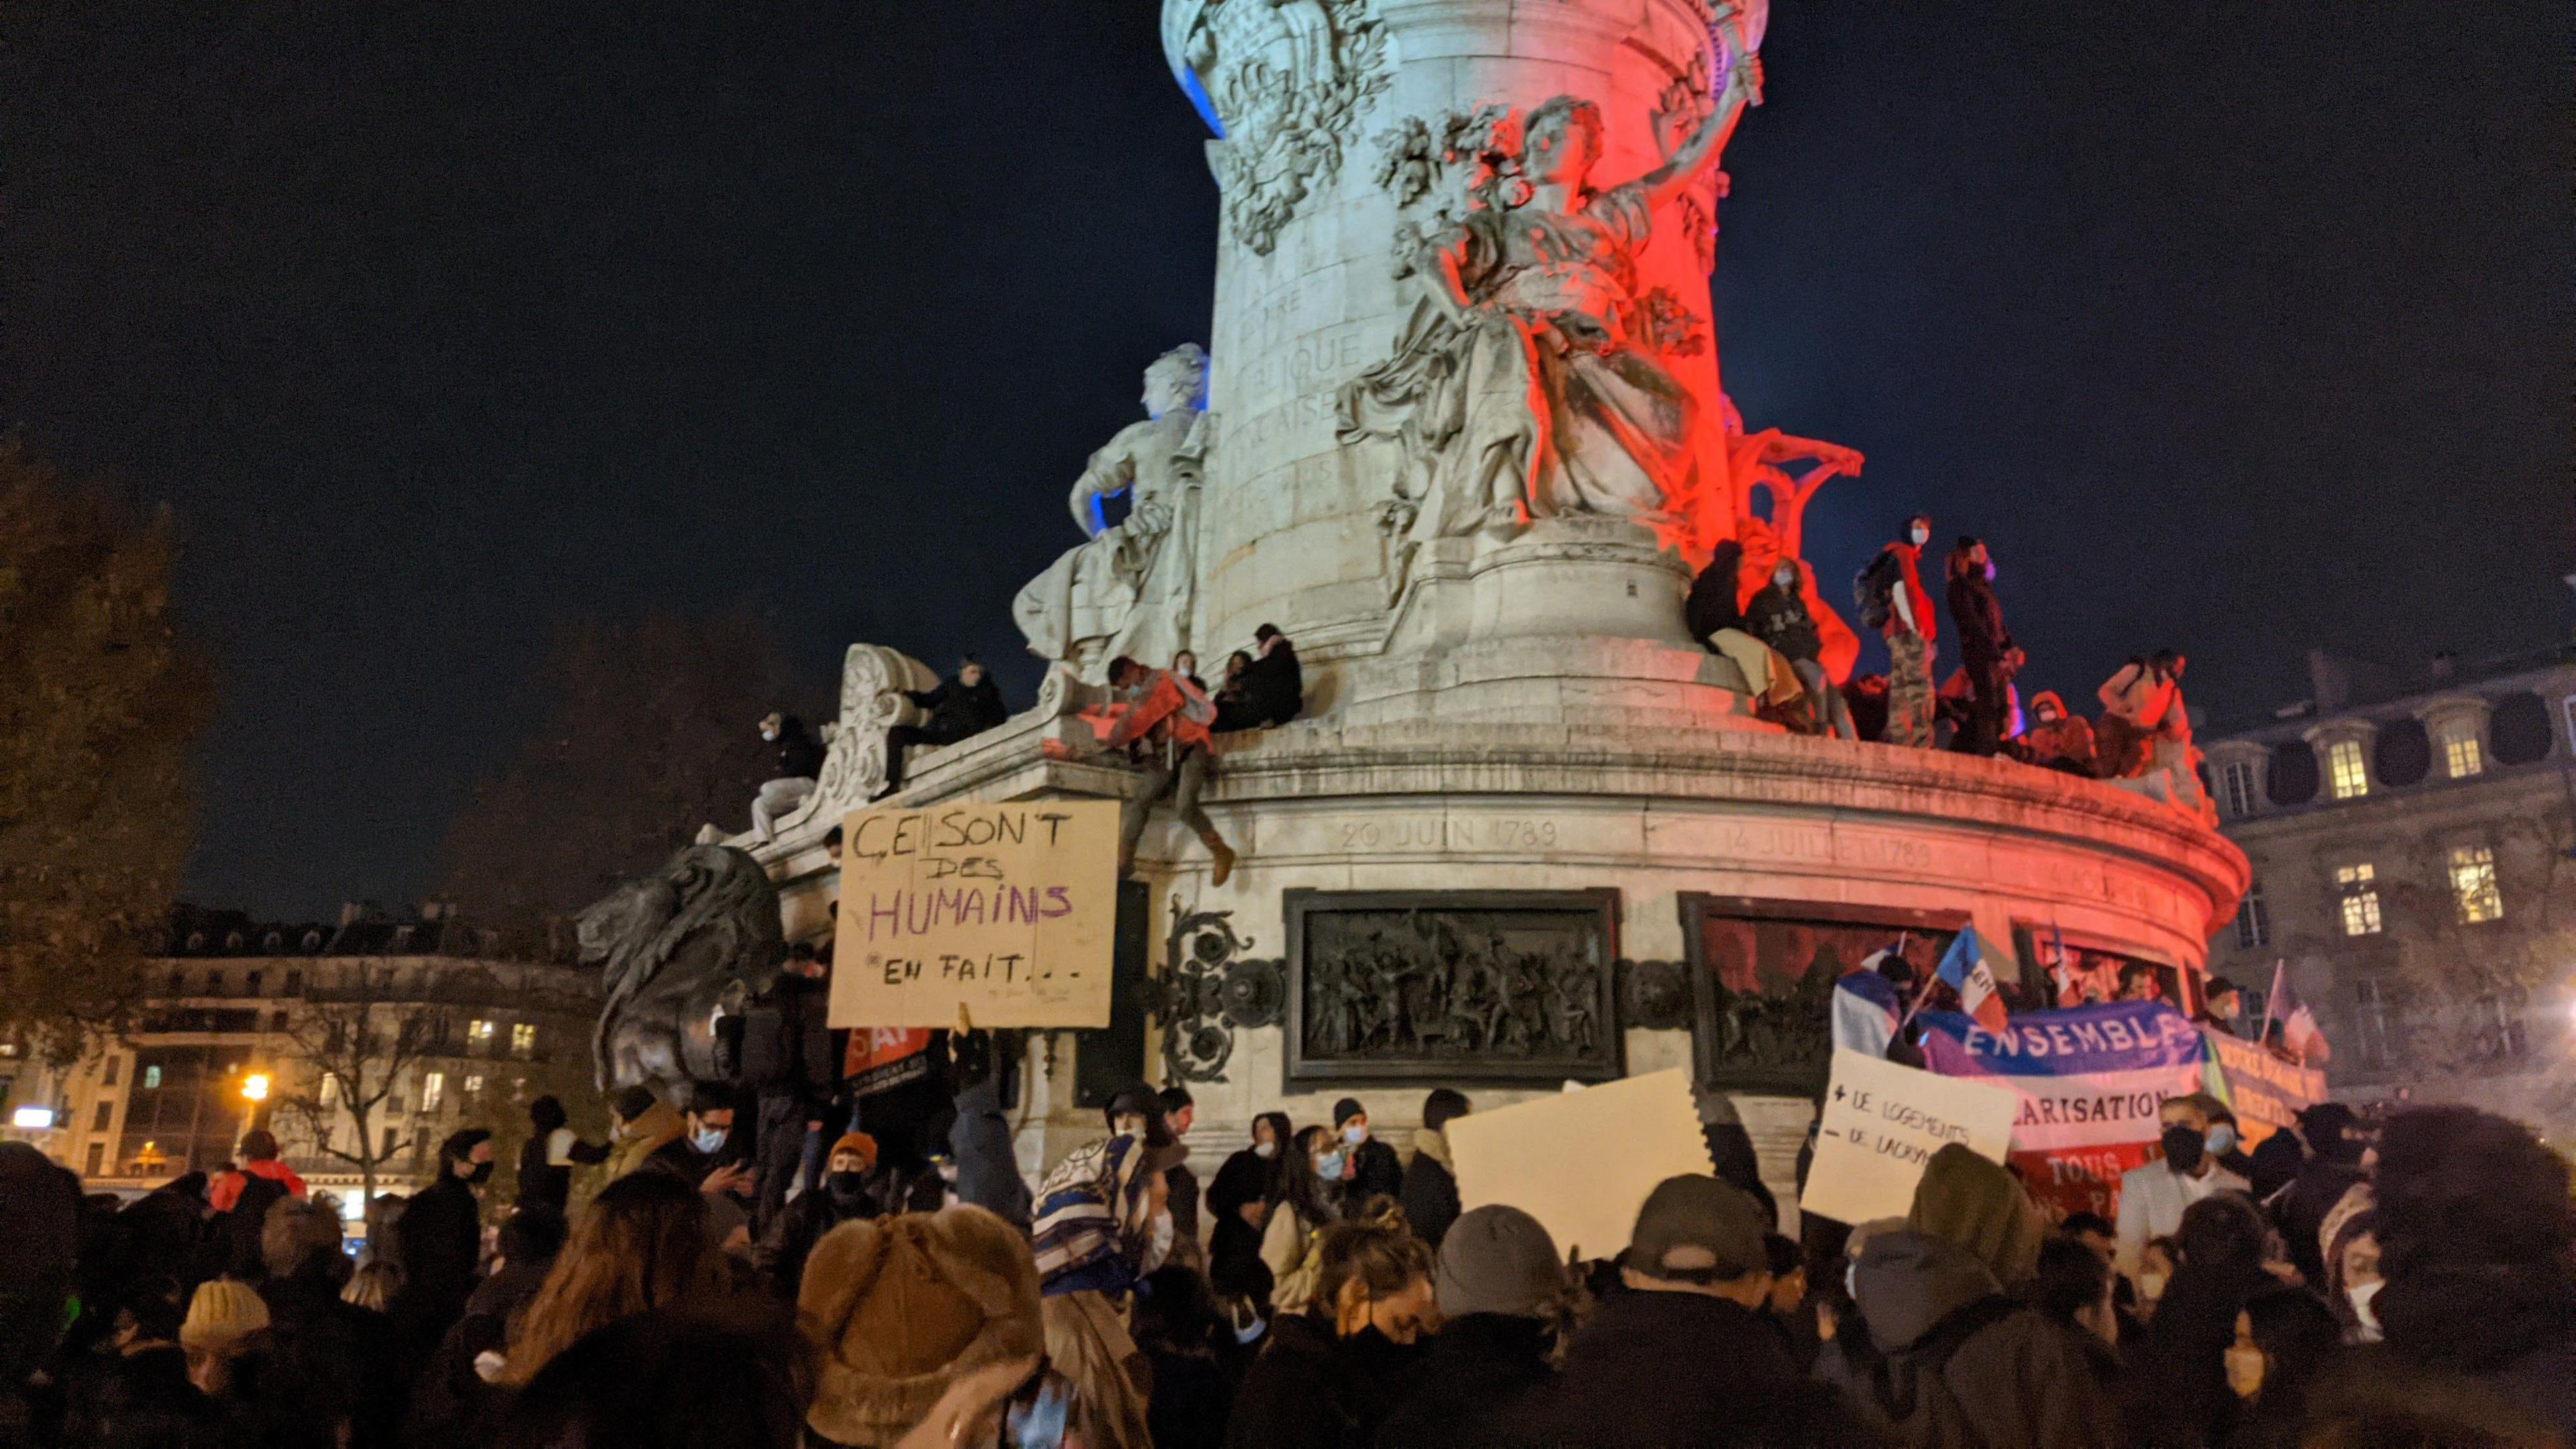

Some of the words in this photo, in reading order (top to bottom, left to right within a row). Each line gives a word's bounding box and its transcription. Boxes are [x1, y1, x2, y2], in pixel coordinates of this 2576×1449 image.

[934, 811, 1073, 847] SONT
[1341, 822, 1381, 848] 20
[1395, 820, 1474, 847] JUIN
[1489, 820, 1556, 847] 1789
[1760, 830, 1870, 862] JUILLET
[1880, 838, 1931, 867] 1789
[919, 857, 1004, 880] DES
[884, 959, 922, 985] EN
[2047, 1150, 2122, 1185] TOUS
